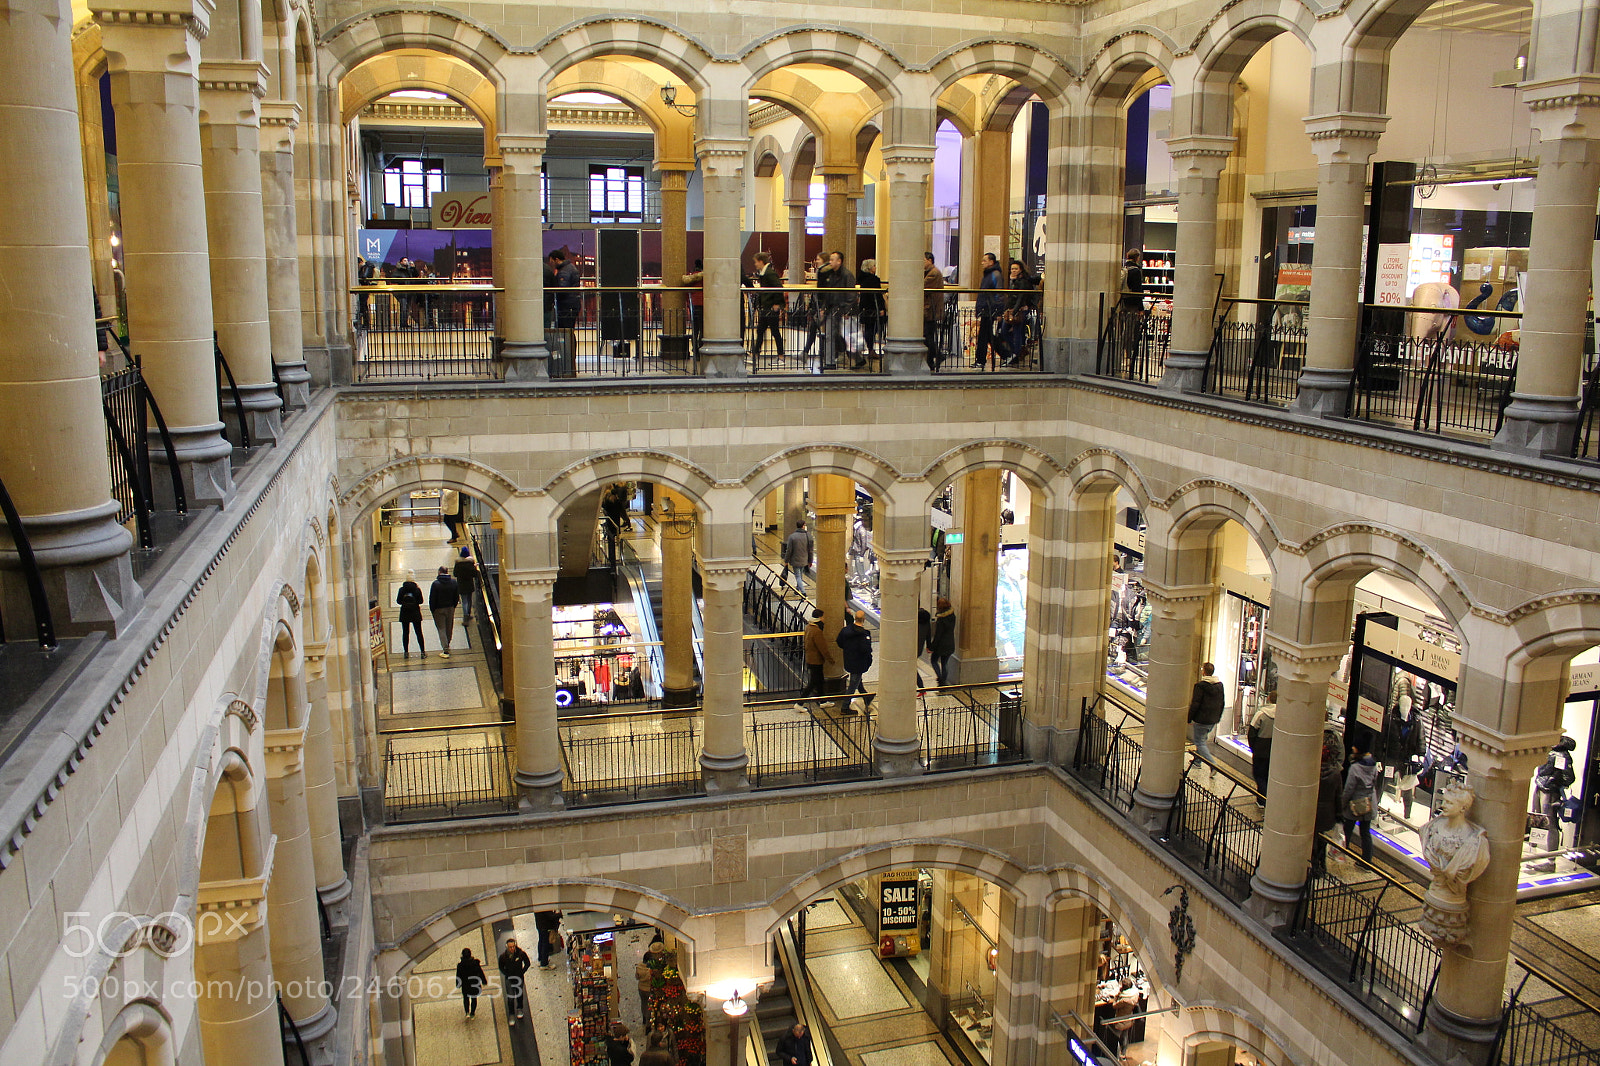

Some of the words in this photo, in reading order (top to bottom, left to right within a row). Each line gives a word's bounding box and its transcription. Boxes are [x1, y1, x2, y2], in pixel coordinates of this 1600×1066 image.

[1380, 292, 1401, 304] 50%
[883, 887, 915, 903] SALE
[882, 907, 892, 917] 10
[897, 906, 916, 916] 50%
[882, 915, 916, 925] DISCOUNT
